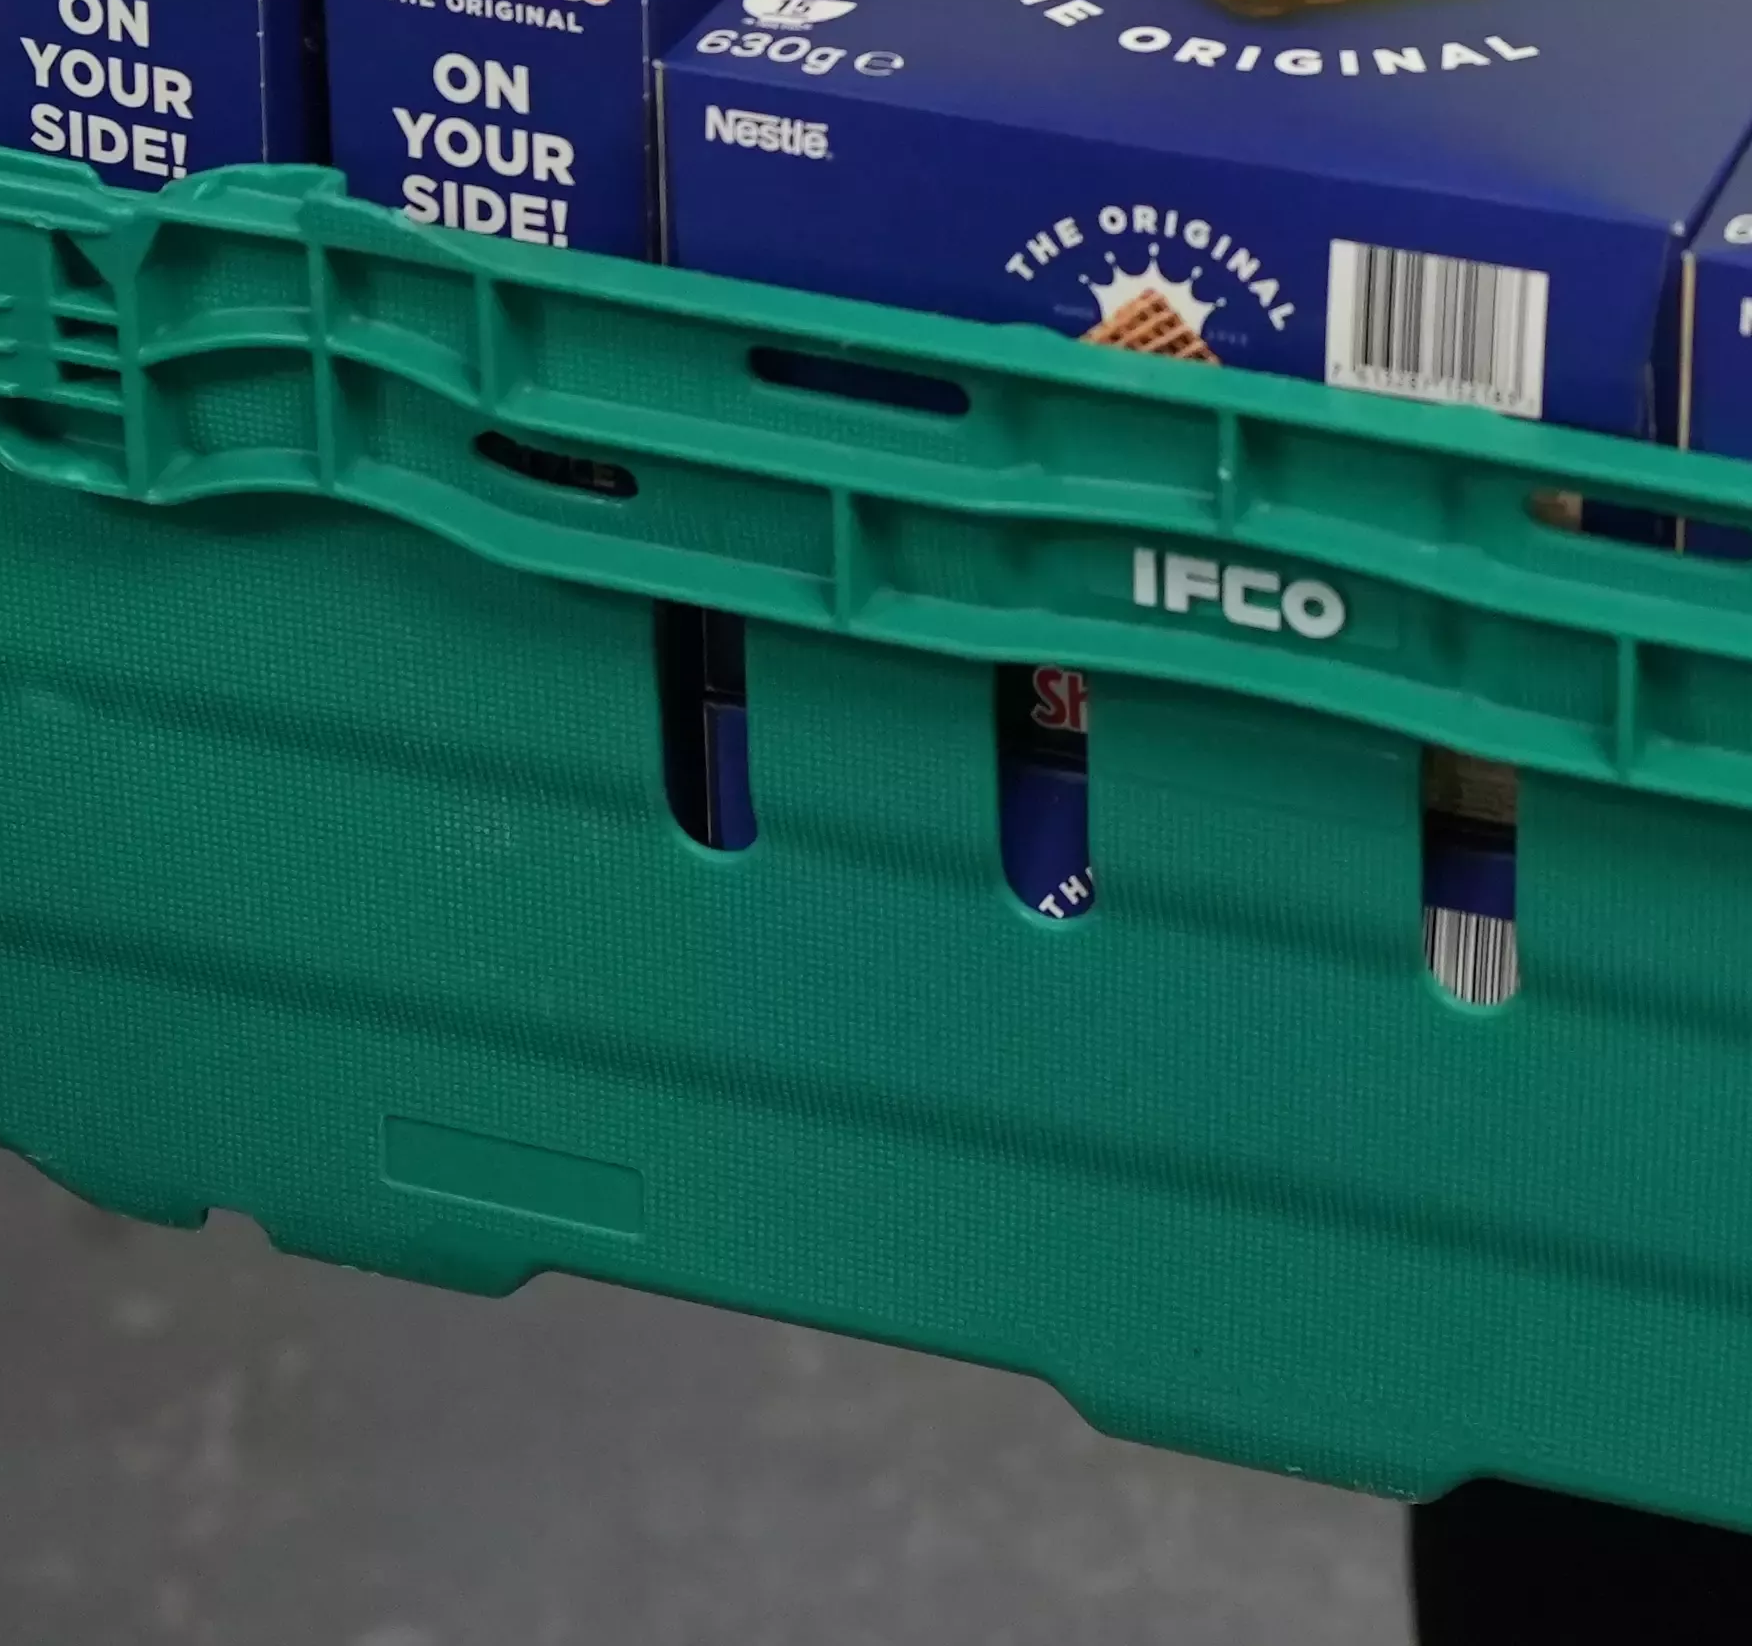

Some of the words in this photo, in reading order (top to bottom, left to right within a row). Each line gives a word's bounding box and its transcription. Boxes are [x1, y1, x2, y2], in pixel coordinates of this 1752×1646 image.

[20, 37, 193, 119] YOUR
[432, 52, 530, 114] ON
[696, 29, 848, 75] 630g
[1117, 23, 1539, 78] ORIGINAL
[30, 103, 188, 179] SIDE!
[392, 107, 576, 186] YOUR
[704, 105, 830, 159] Nestlé
[402, 175, 569, 248] SIDE!
[1005, 216, 1084, 282] THE
[1098, 204, 1296, 331] ORIGINAL
[1132, 548, 1346, 639] IFCO
[1039, 866, 1094, 919] TH
